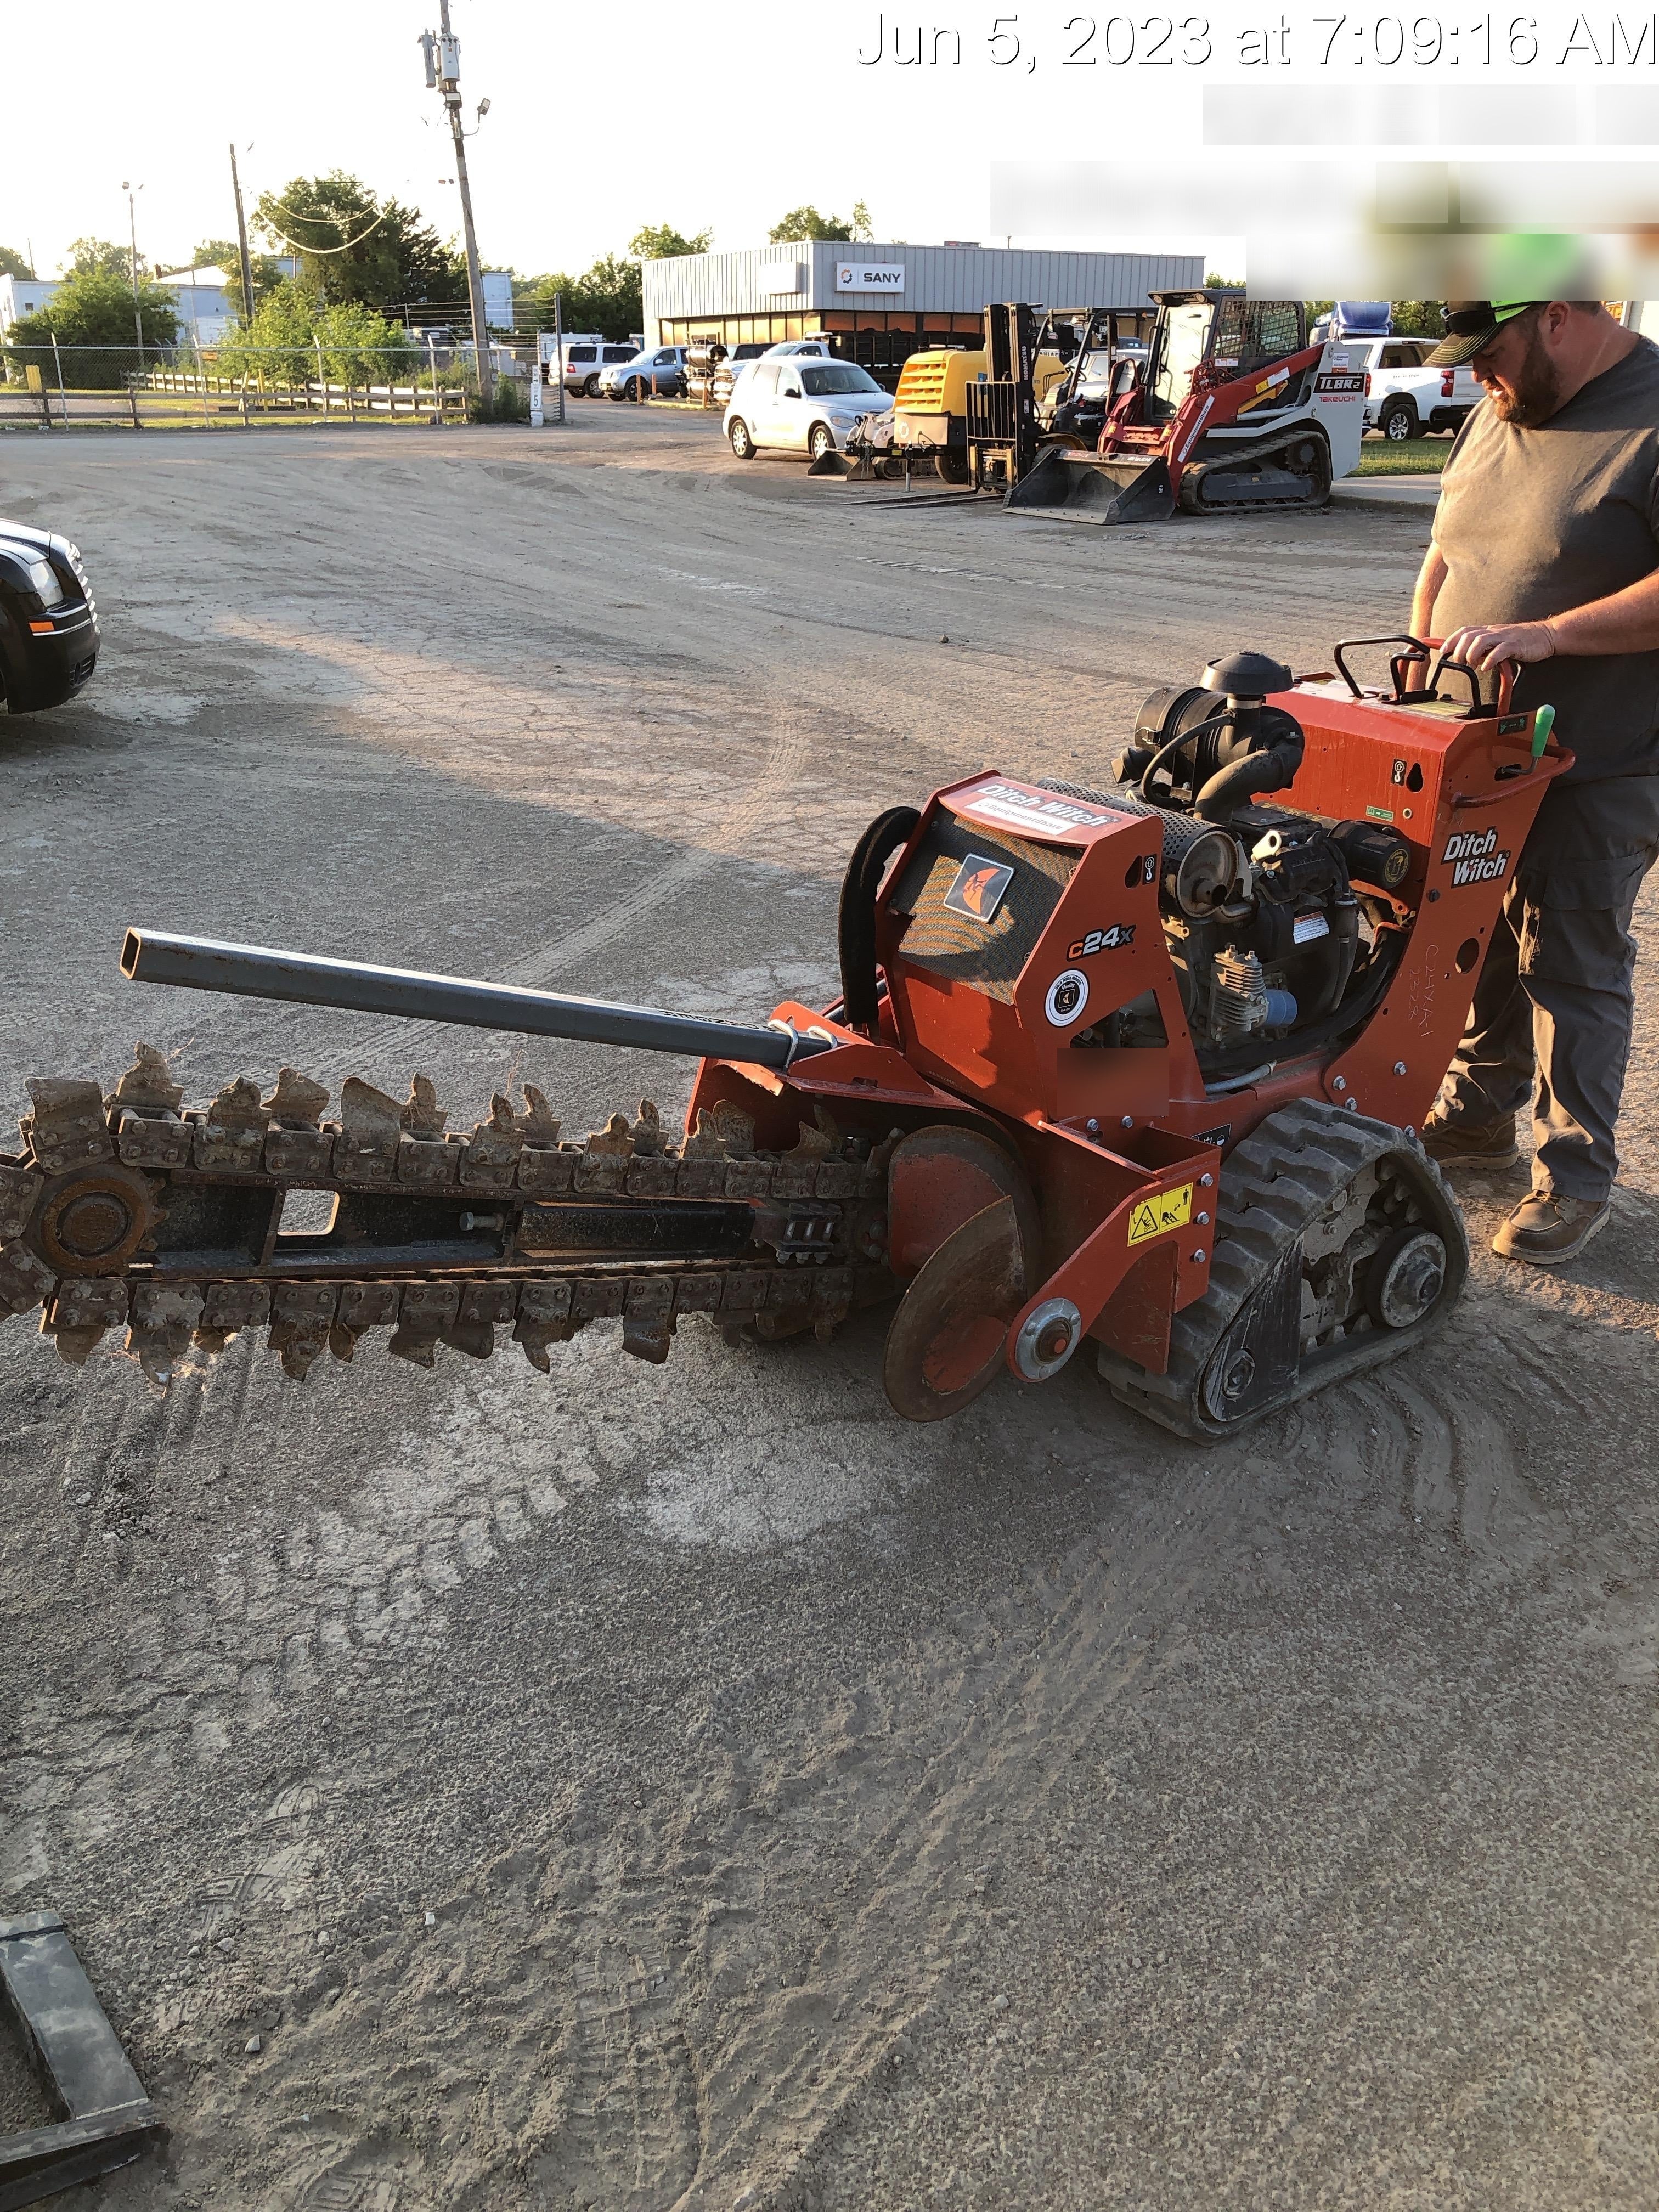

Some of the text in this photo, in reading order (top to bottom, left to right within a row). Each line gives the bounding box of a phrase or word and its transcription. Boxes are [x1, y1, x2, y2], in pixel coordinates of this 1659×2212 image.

[864, 272, 901, 283] SANY
[533, 394, 538, 407] 5
[977, 785, 1109, 827] Ditch Witch
[988, 804, 1063, 830] EquipmentShare
[1443, 829, 1497, 861] Ditch
